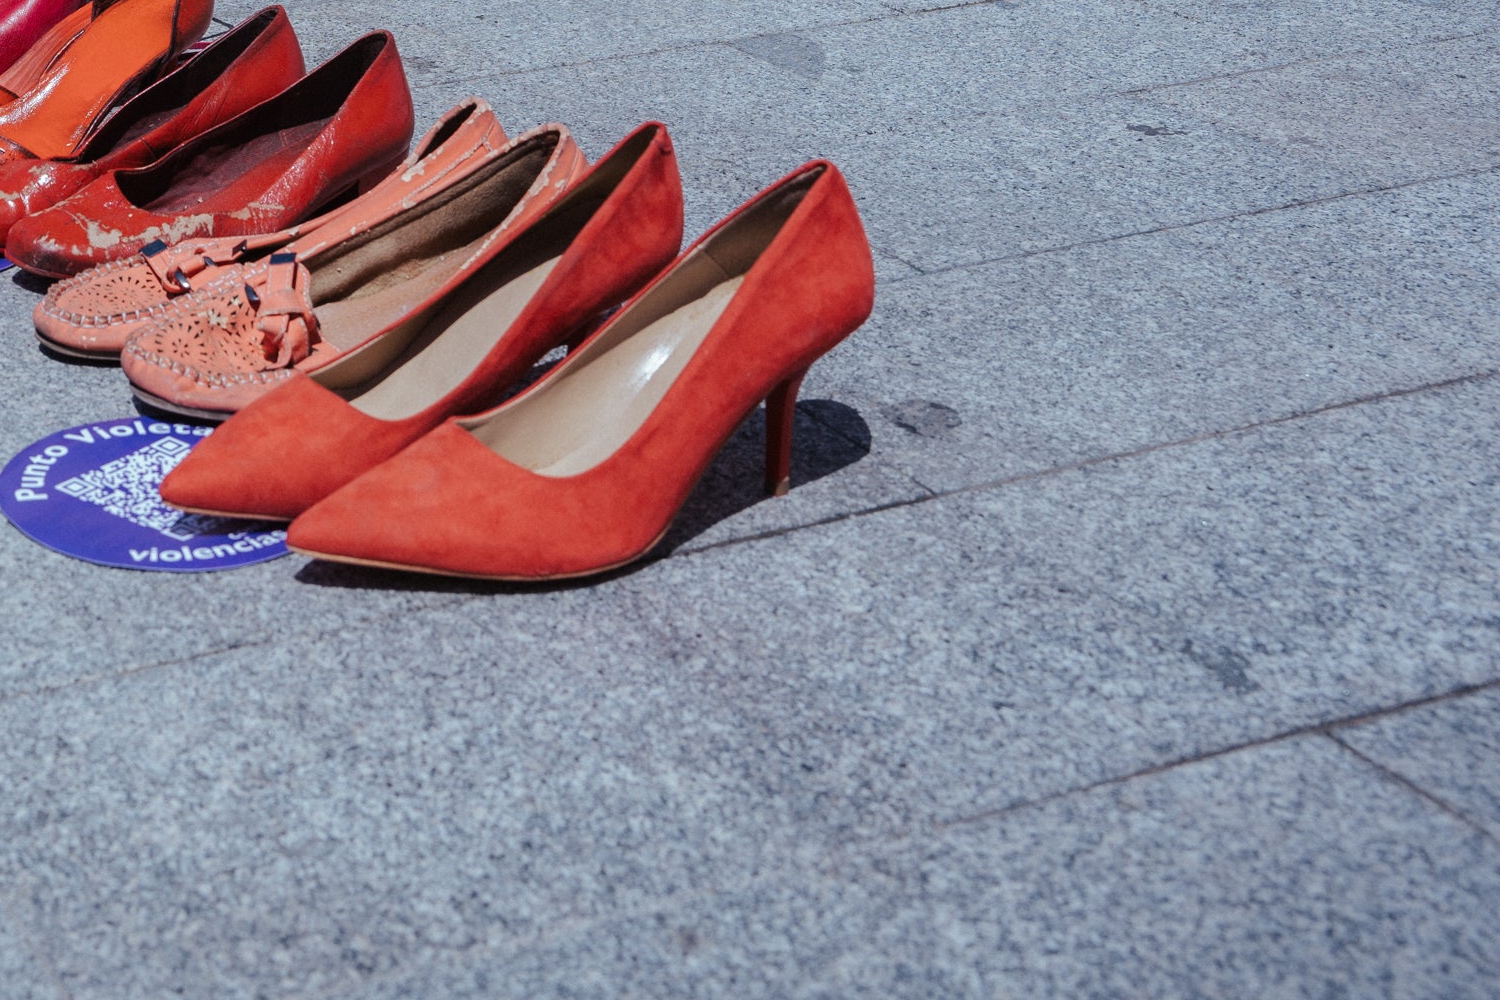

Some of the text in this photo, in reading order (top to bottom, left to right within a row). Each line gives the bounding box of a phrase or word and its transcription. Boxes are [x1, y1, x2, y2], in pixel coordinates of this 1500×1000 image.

[14, 420, 215, 502] Punto Violeta
[128, 529, 288, 563] violencias
